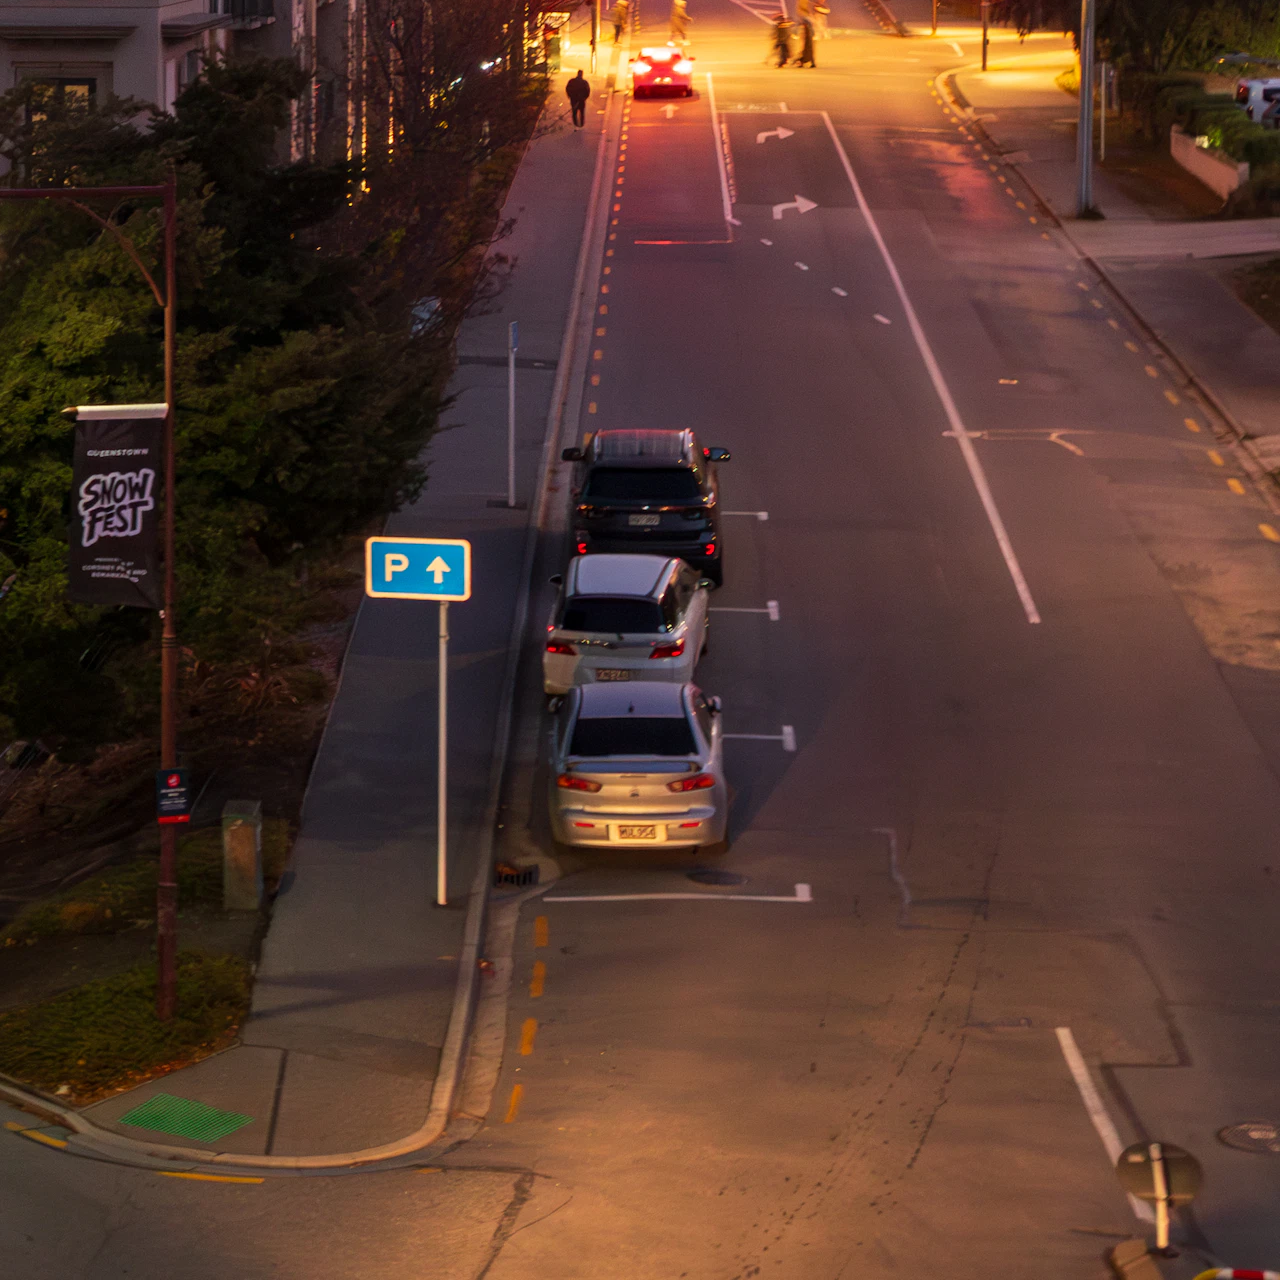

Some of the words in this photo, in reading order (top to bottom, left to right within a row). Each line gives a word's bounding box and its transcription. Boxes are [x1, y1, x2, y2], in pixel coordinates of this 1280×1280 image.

[86, 448, 149, 458] QUEENSTOWN
[81, 470, 153, 513] SNOW
[83, 500, 152, 544] FEST
[384, 553, 409, 582] P
